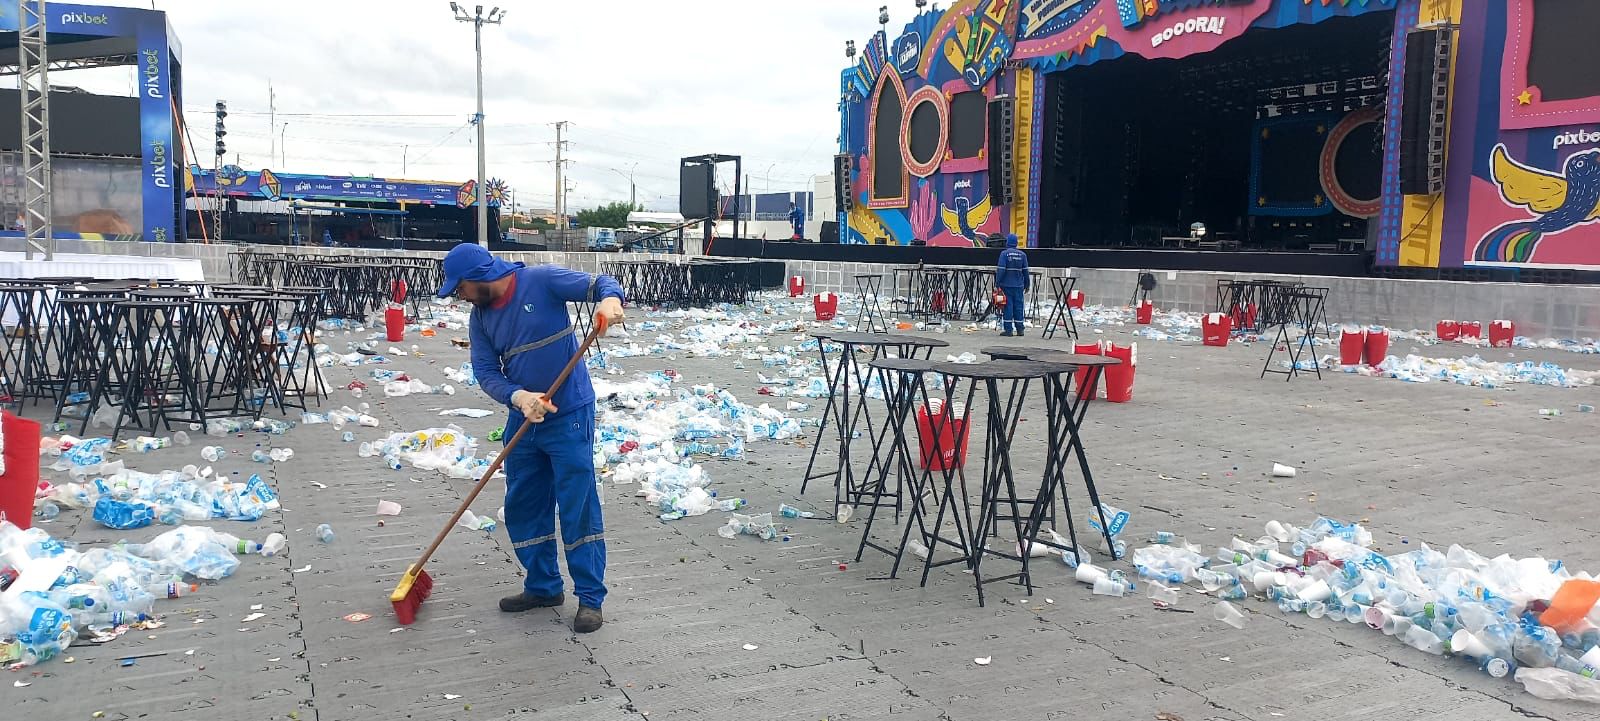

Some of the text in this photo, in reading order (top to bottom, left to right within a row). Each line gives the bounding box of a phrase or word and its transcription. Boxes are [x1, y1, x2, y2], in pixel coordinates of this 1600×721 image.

[61, 11, 108, 25] pixbet
[1151, 16, 1225, 48] BOOORA!
[142, 48, 164, 98] pixbet
[149, 138, 171, 188] pixbet
[1111, 514, 1125, 532] CUBO
